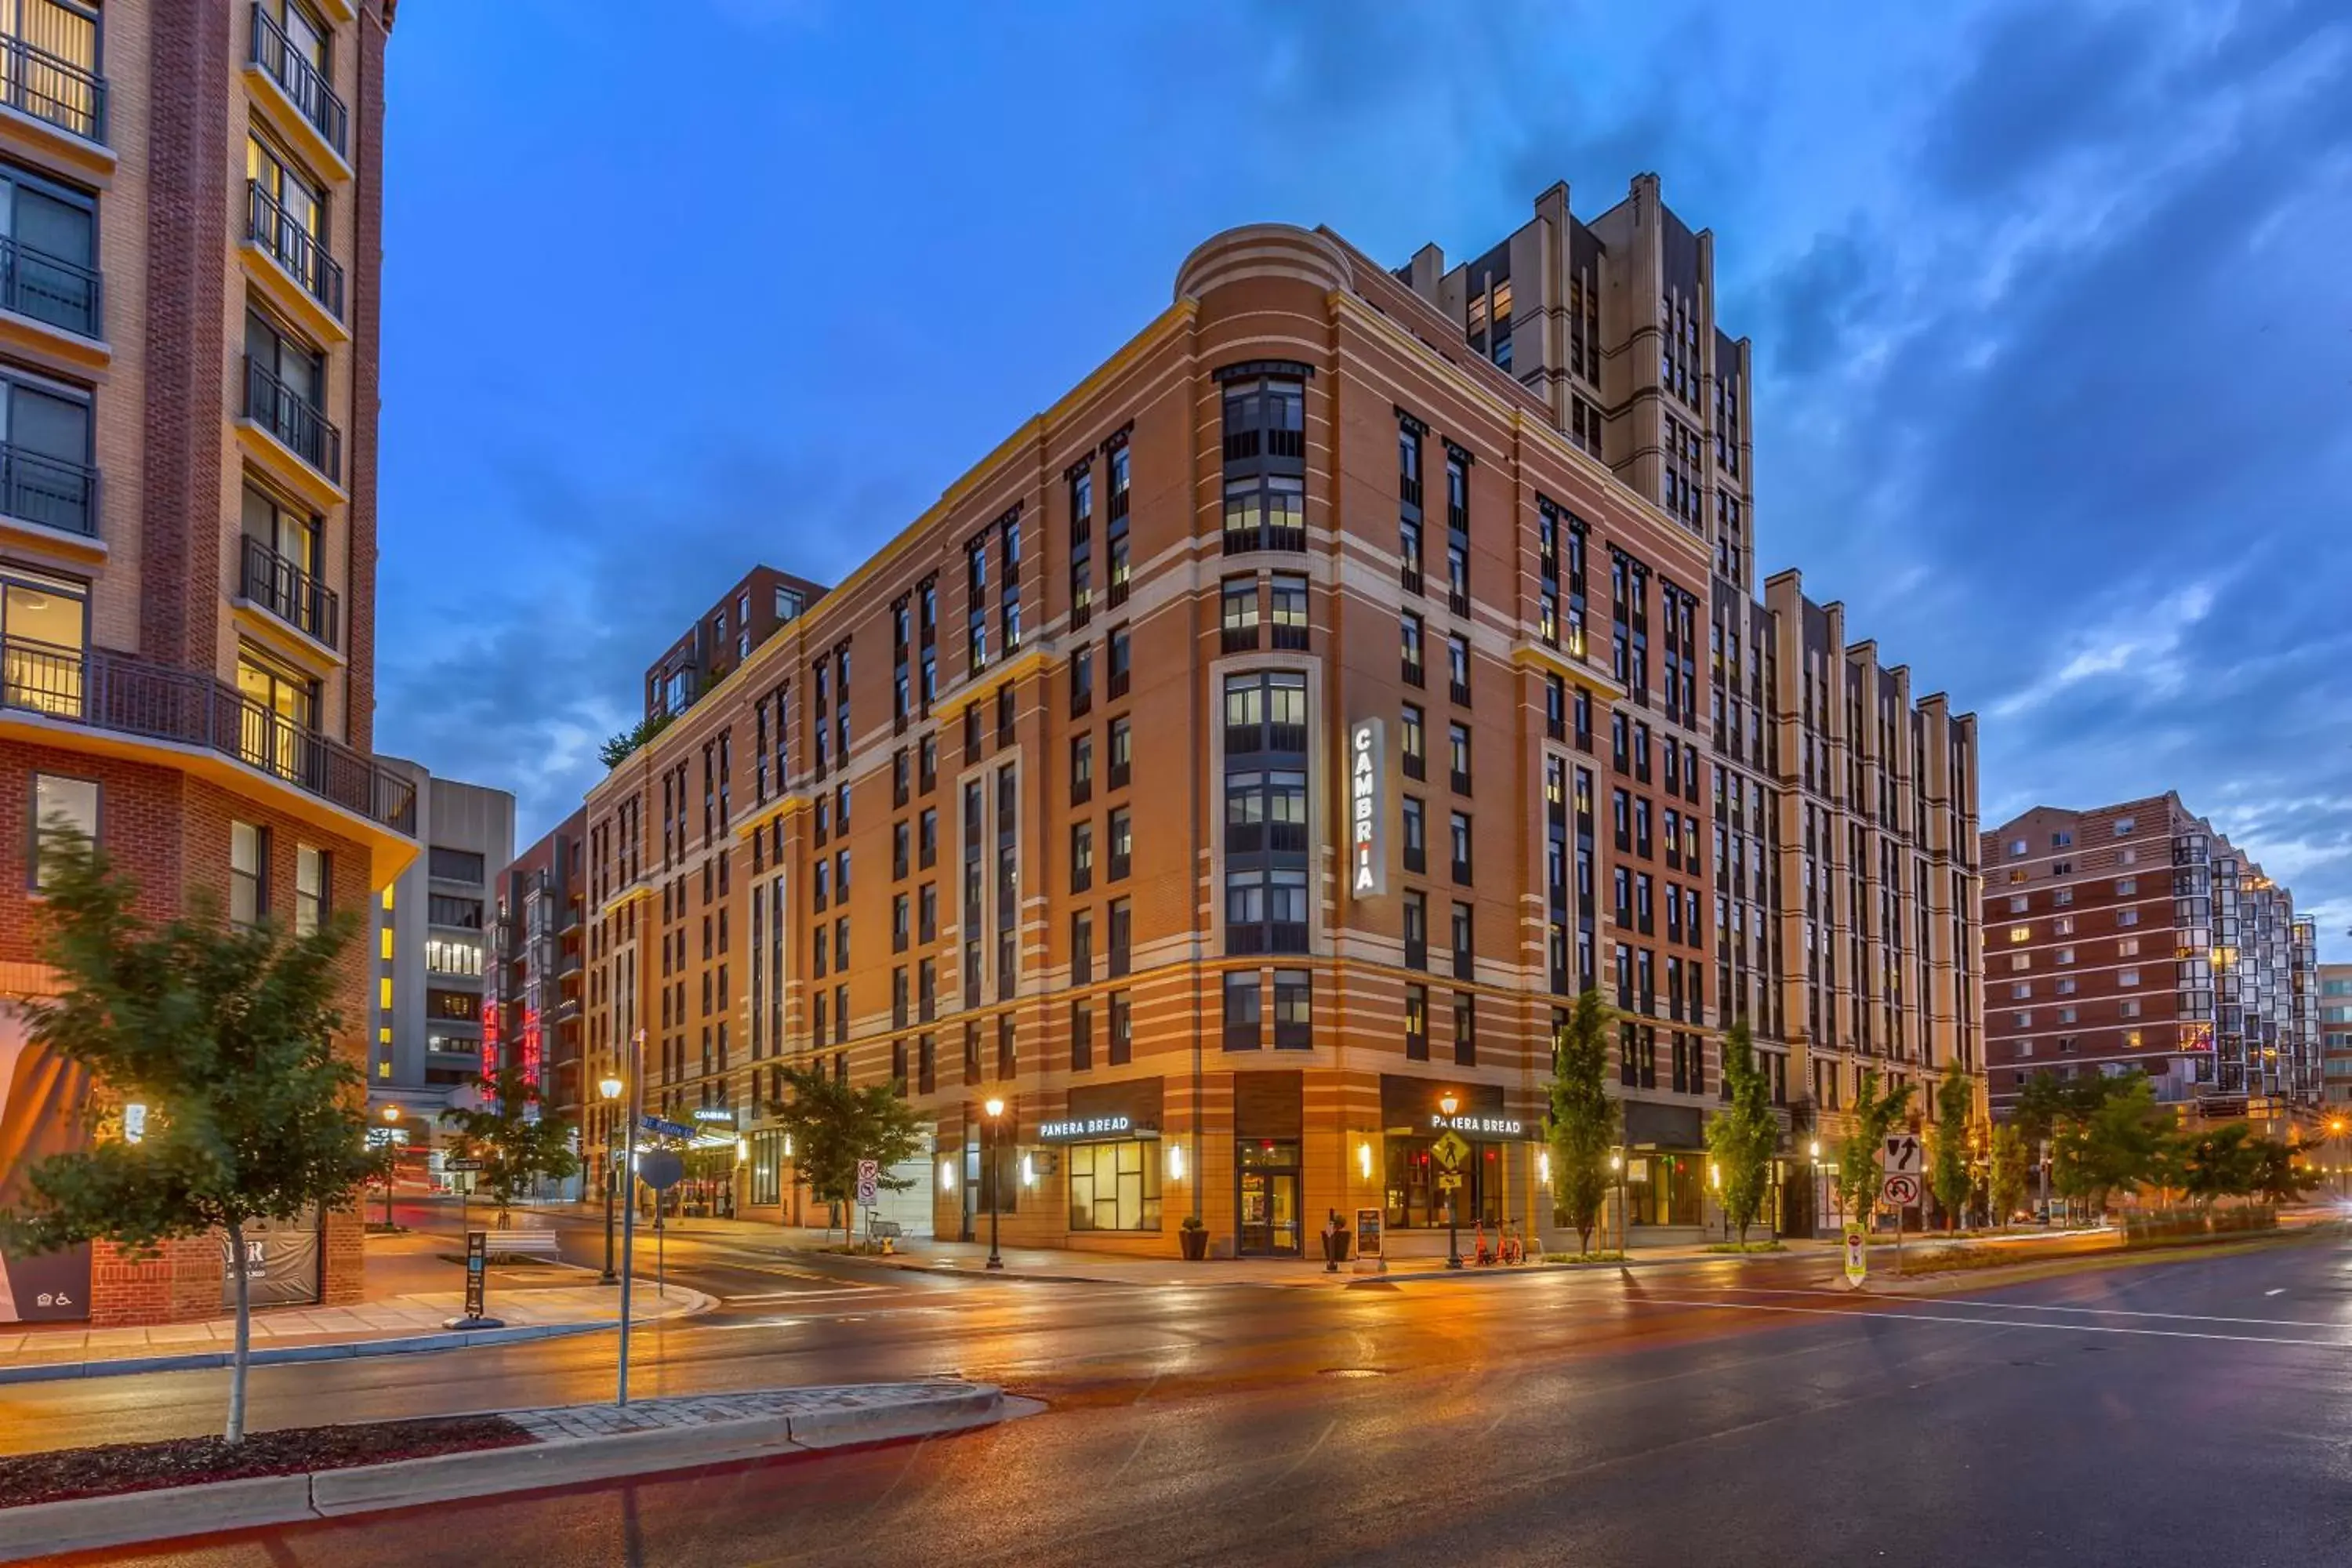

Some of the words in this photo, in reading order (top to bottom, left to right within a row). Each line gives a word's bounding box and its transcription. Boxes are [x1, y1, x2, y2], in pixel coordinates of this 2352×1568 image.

[1355, 728, 1374, 890] CAMBRIA
[1040, 1122, 1084, 1138] PANERA
[1088, 1116, 1129, 1134] BREAD
[1483, 1119, 1521, 1134] BREAD
